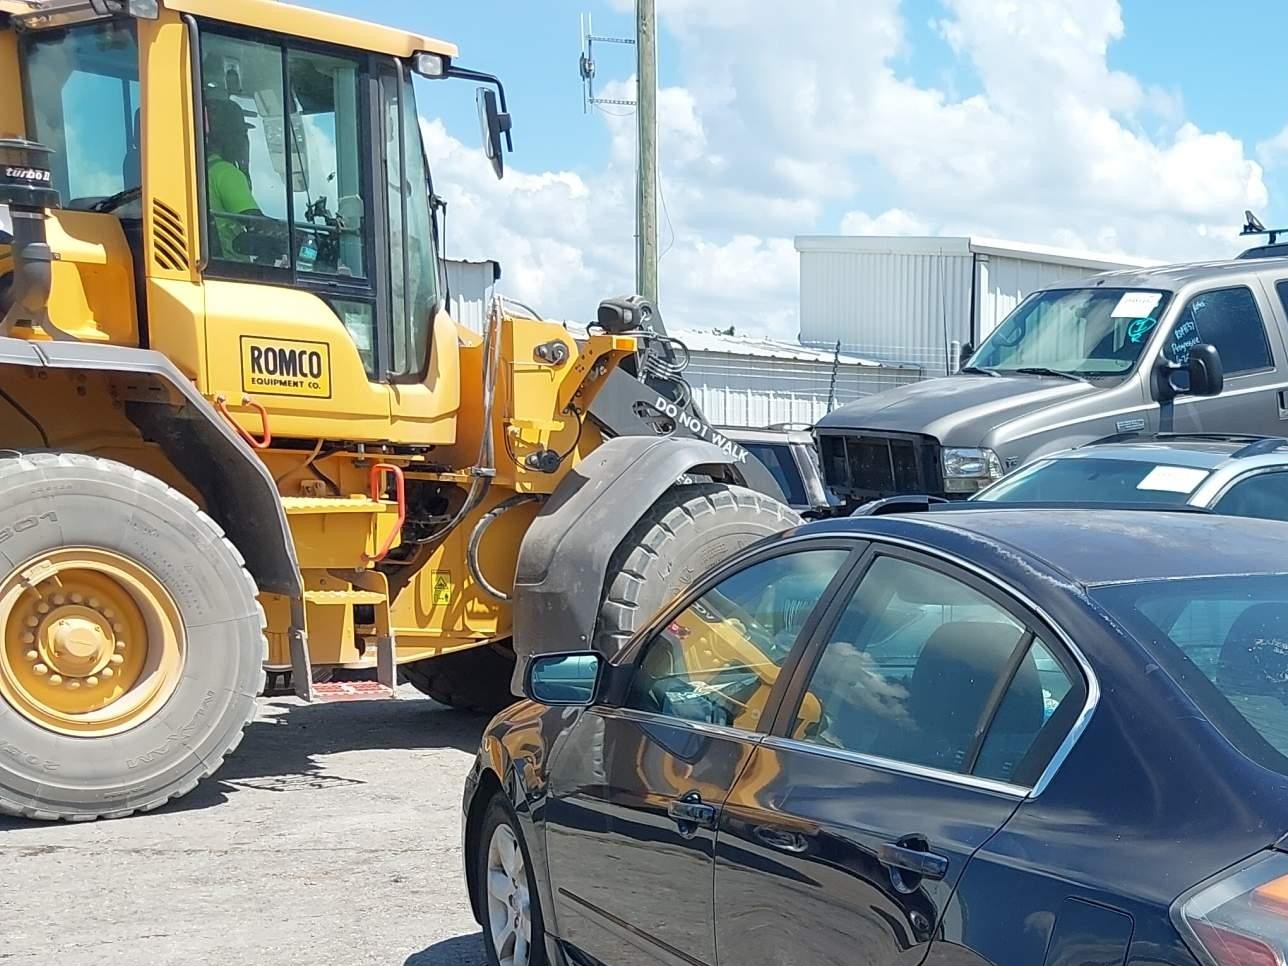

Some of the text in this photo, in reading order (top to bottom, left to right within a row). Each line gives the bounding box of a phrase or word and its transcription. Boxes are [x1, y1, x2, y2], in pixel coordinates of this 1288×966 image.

[6, 167, 42, 180] turbo
[250, 345, 322, 379] ROMCO
[251, 377, 321, 390] EQUIPMENT CO.
[655, 396, 749, 464] DO NOT WALK
